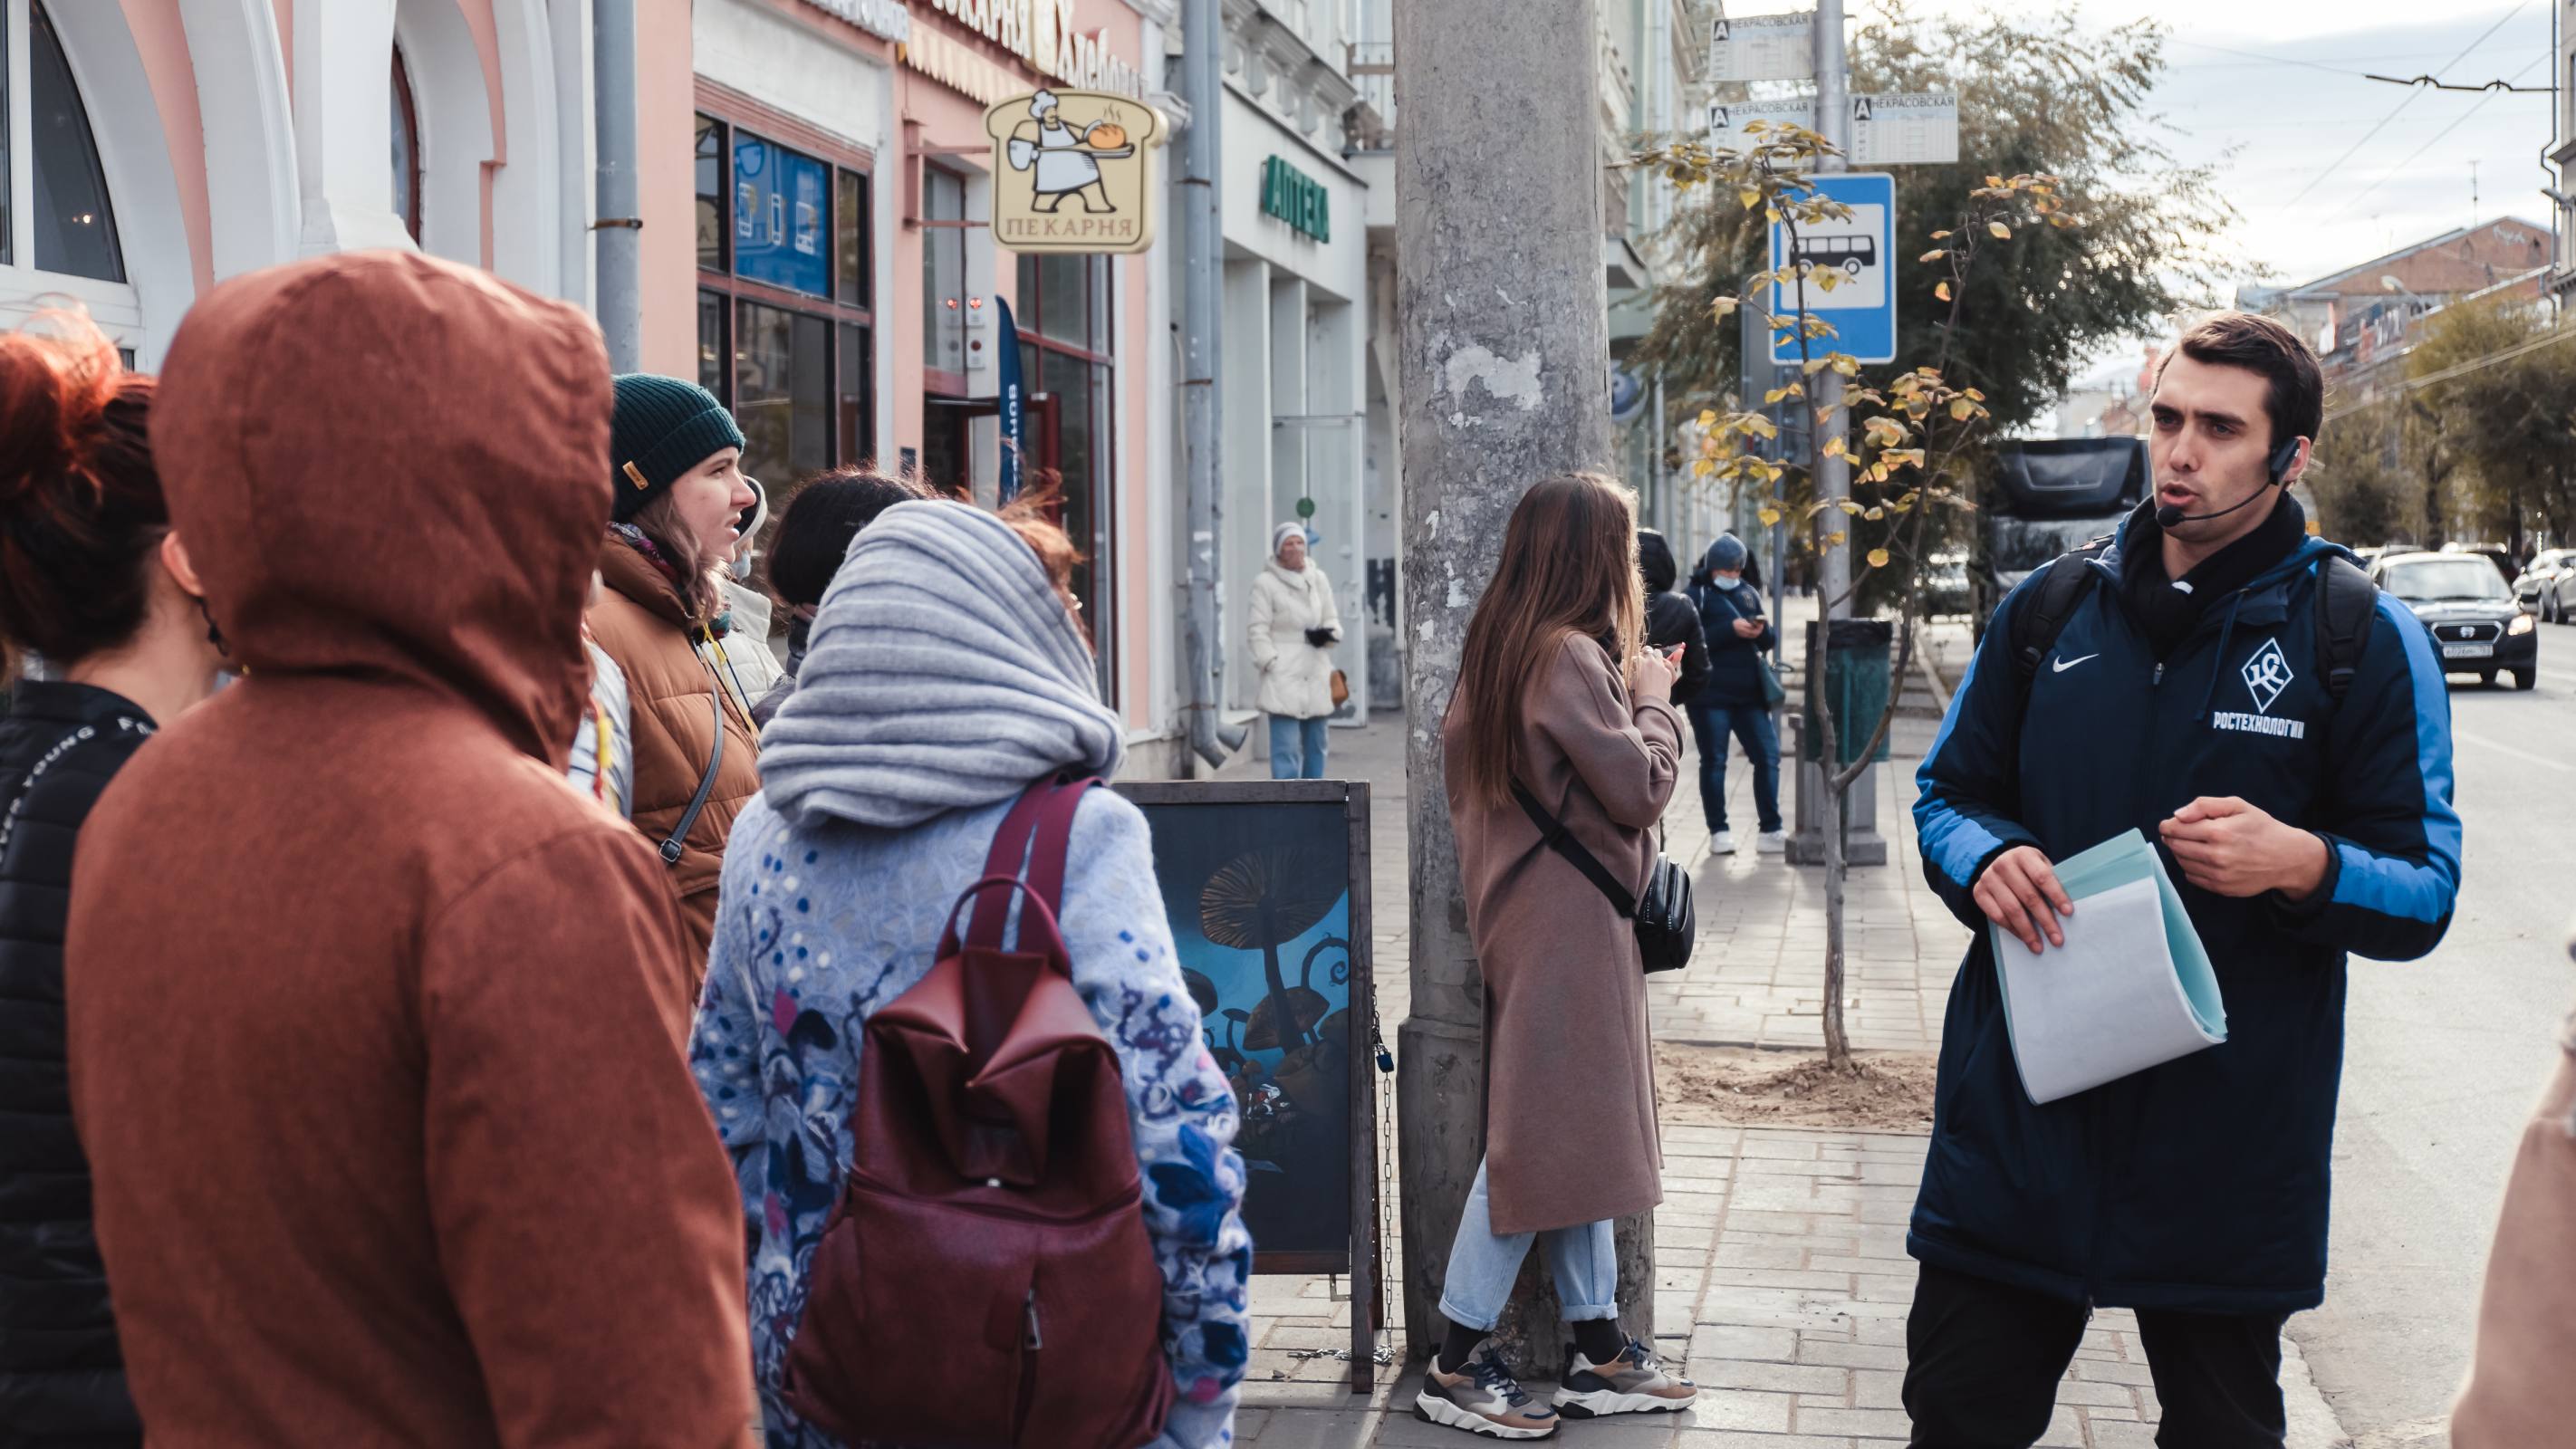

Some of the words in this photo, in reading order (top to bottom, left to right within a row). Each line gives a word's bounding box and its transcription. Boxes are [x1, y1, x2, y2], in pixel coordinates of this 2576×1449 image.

[1871, 96, 1955, 109] НЕКРАСОВСКАЯ
[1264, 154, 1329, 244] АПТЕКА
[1005, 217, 1133, 236] ПЕКАРНЯ
[2213, 711, 2305, 739] РОСТЕХНОЛОГИИ
